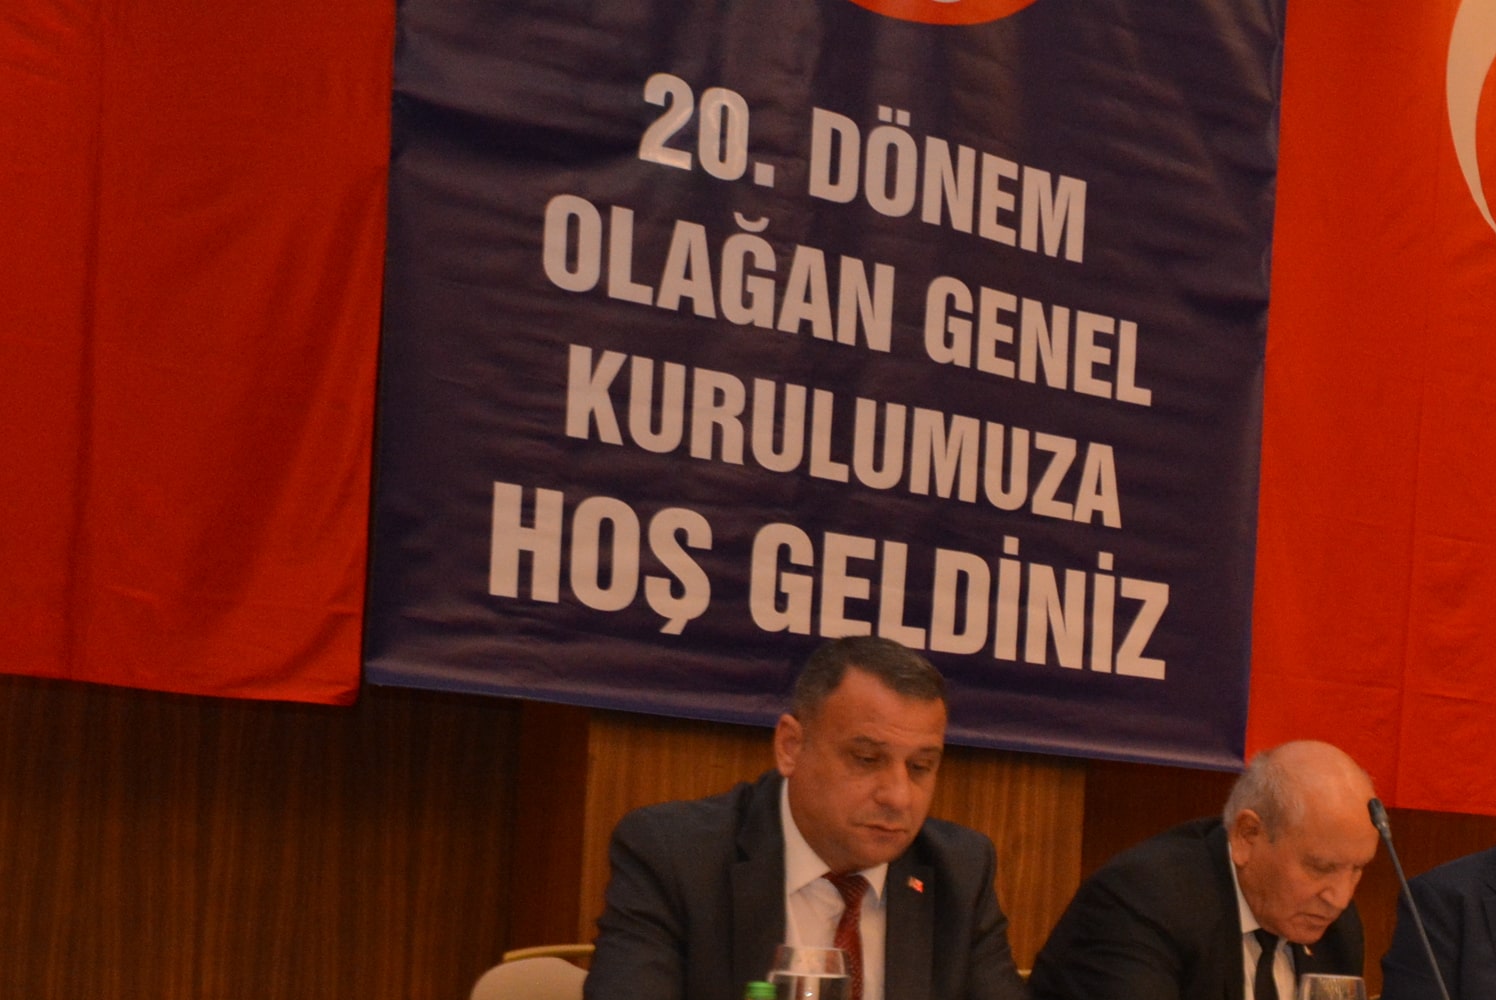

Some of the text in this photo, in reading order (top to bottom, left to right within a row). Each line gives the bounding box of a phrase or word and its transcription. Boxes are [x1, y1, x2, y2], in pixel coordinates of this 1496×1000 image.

[639, 72, 1087, 264] 20. DÖNEM
[543, 194, 1152, 407] OLAĞAN GENEL
[565, 343, 1122, 528] KURULUMUZA
[489, 481, 1169, 681] HOŞ GELDİNİZ
